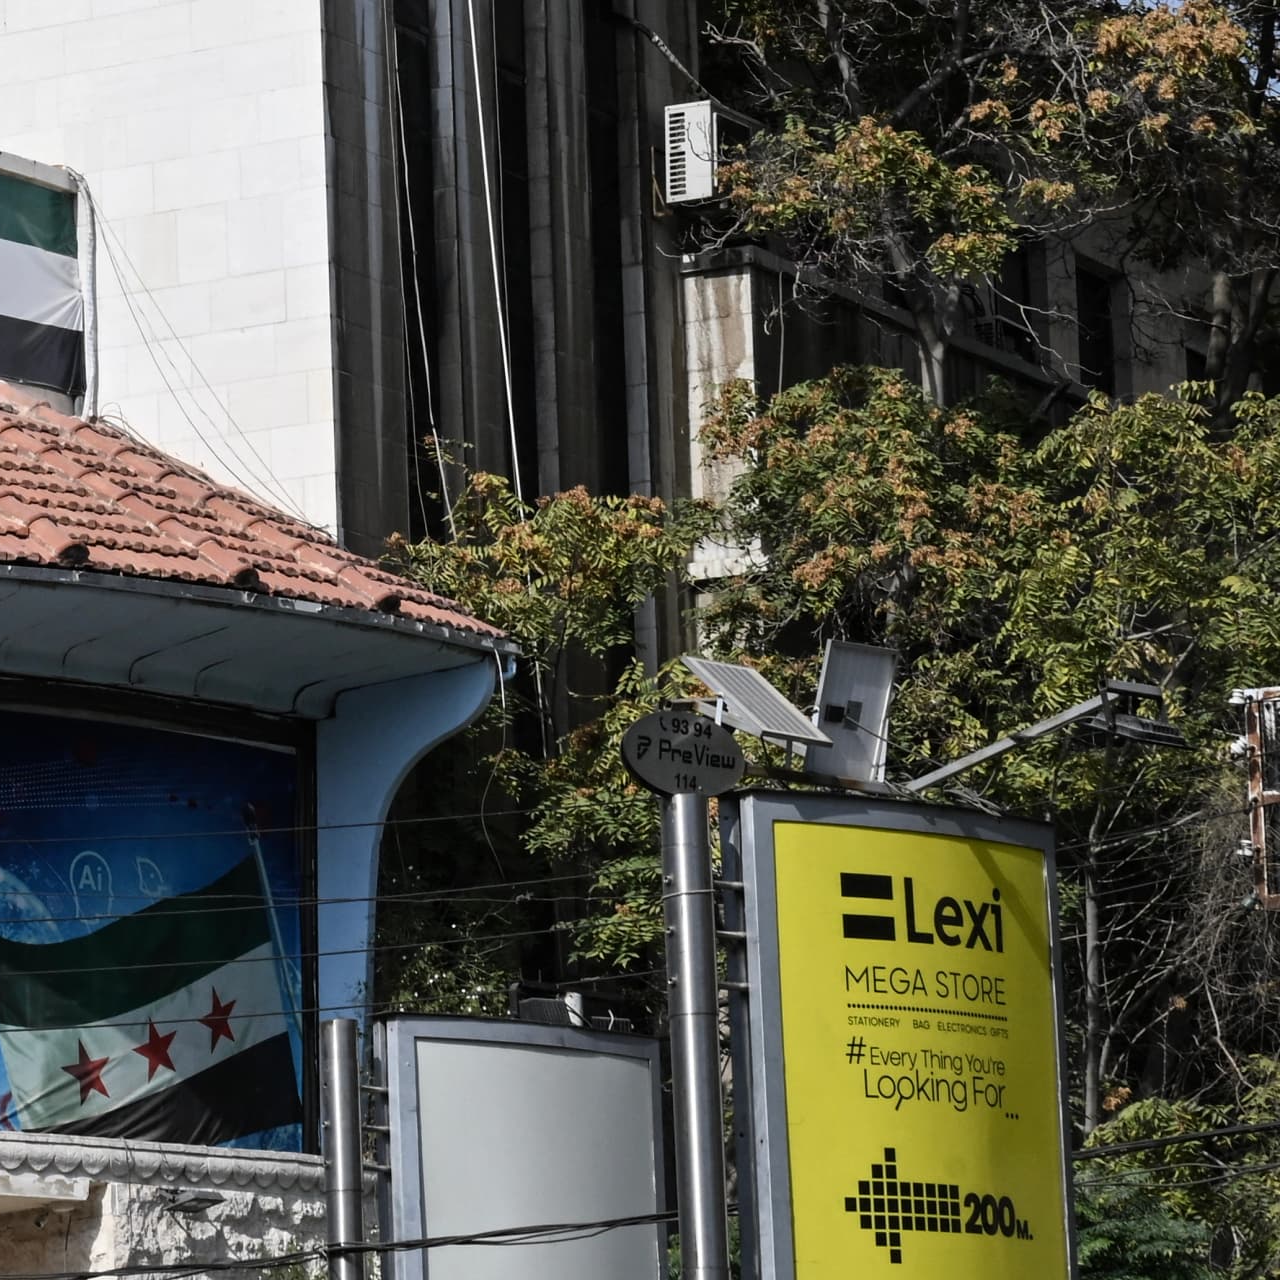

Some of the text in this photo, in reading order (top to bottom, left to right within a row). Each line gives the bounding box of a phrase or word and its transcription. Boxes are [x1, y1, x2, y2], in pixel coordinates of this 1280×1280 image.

[674, 773, 698, 792] 114
[78, 864, 103, 892] Ai
[903, 876, 1005, 953] Lexi
[844, 965, 1007, 1006] MEGA STORE
[847, 1015, 901, 1029] STATIONERY
[912, 1018, 930, 1030] BAG
[937, 1021, 988, 1037] ELECTRONICS
[920, 1049, 964, 1076] Thing
[964, 1053, 1006, 1076] You're
[863, 1068, 968, 1112] Looking
